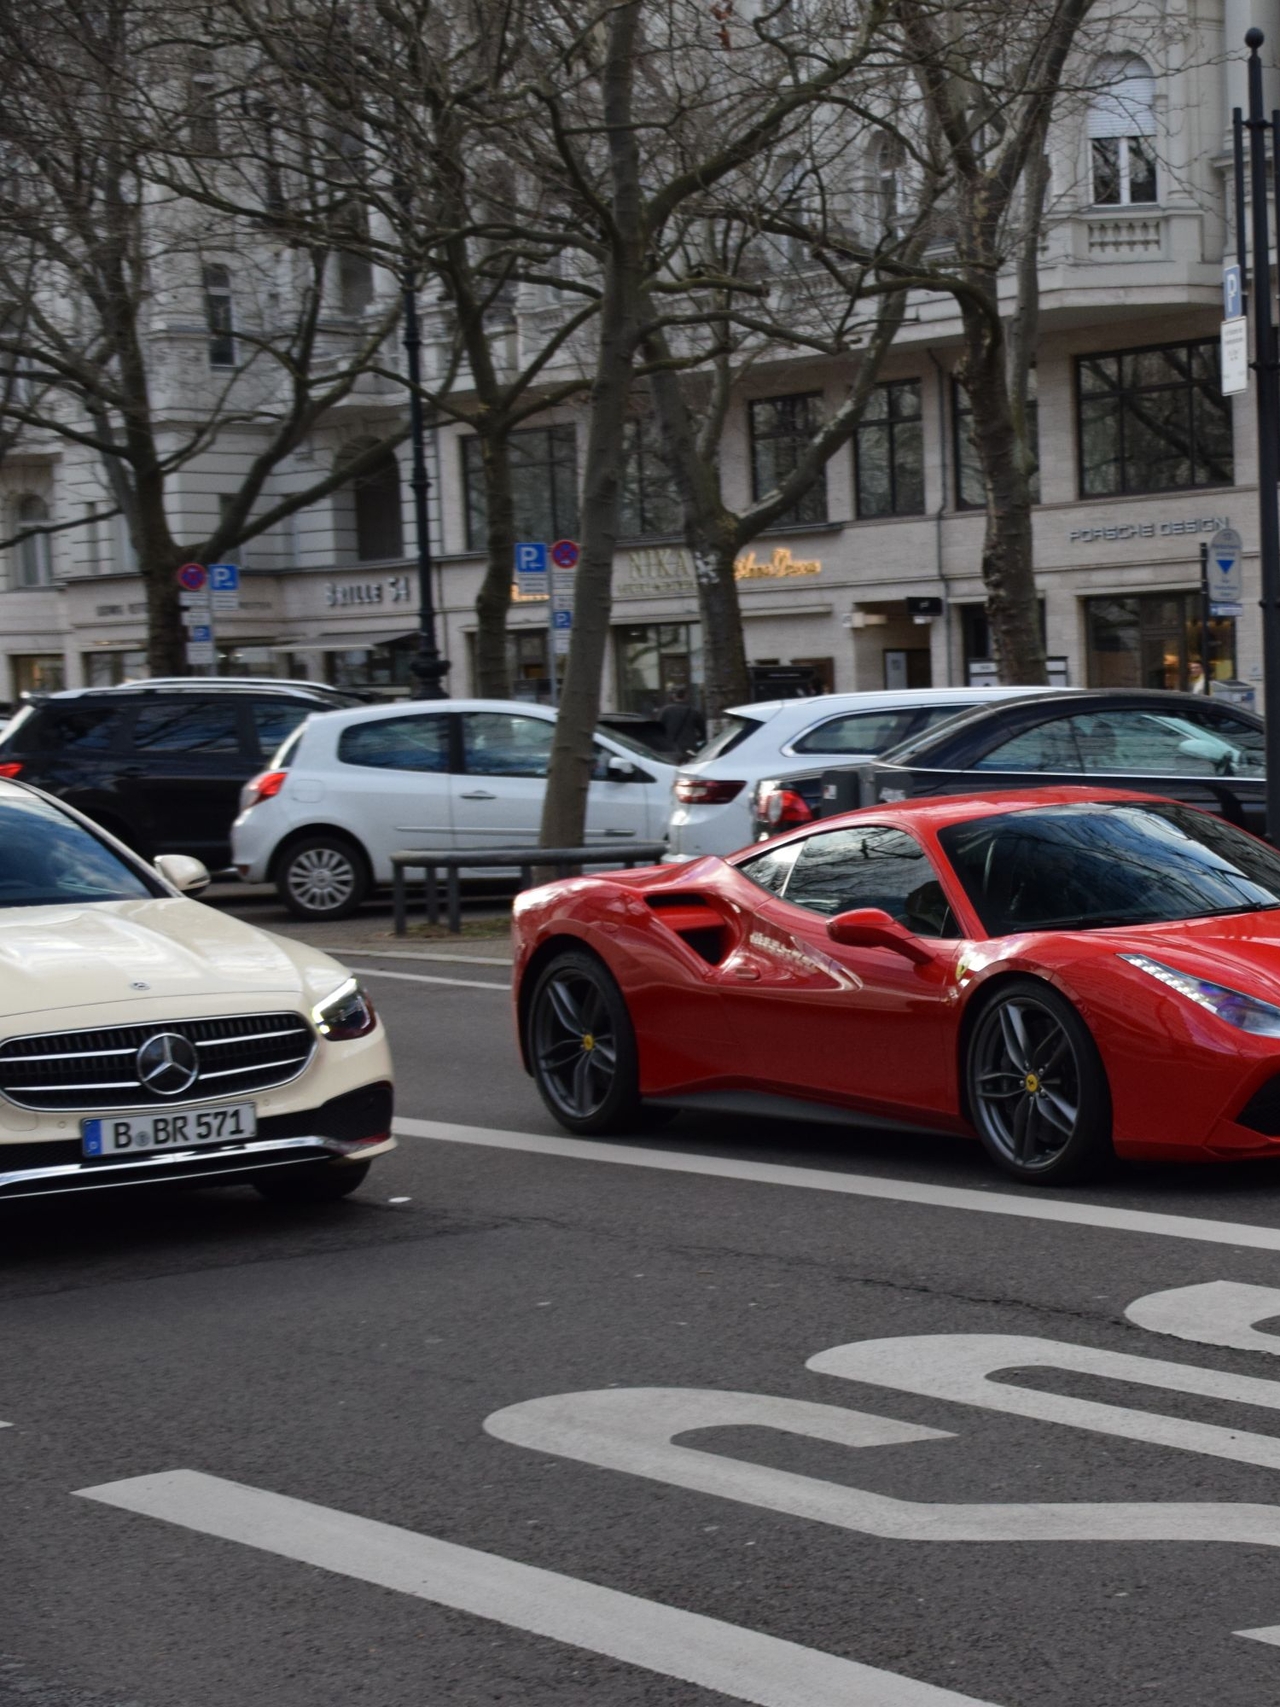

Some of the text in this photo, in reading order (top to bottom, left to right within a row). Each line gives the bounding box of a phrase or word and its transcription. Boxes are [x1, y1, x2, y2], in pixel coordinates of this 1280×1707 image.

[1069, 517, 1229, 544] PORSCHE DESIGN
[520, 546, 537, 569] P
[628, 548, 690, 579] NIKA
[212, 567, 230, 588] P
[113, 1109, 245, 1149] B BR 571
